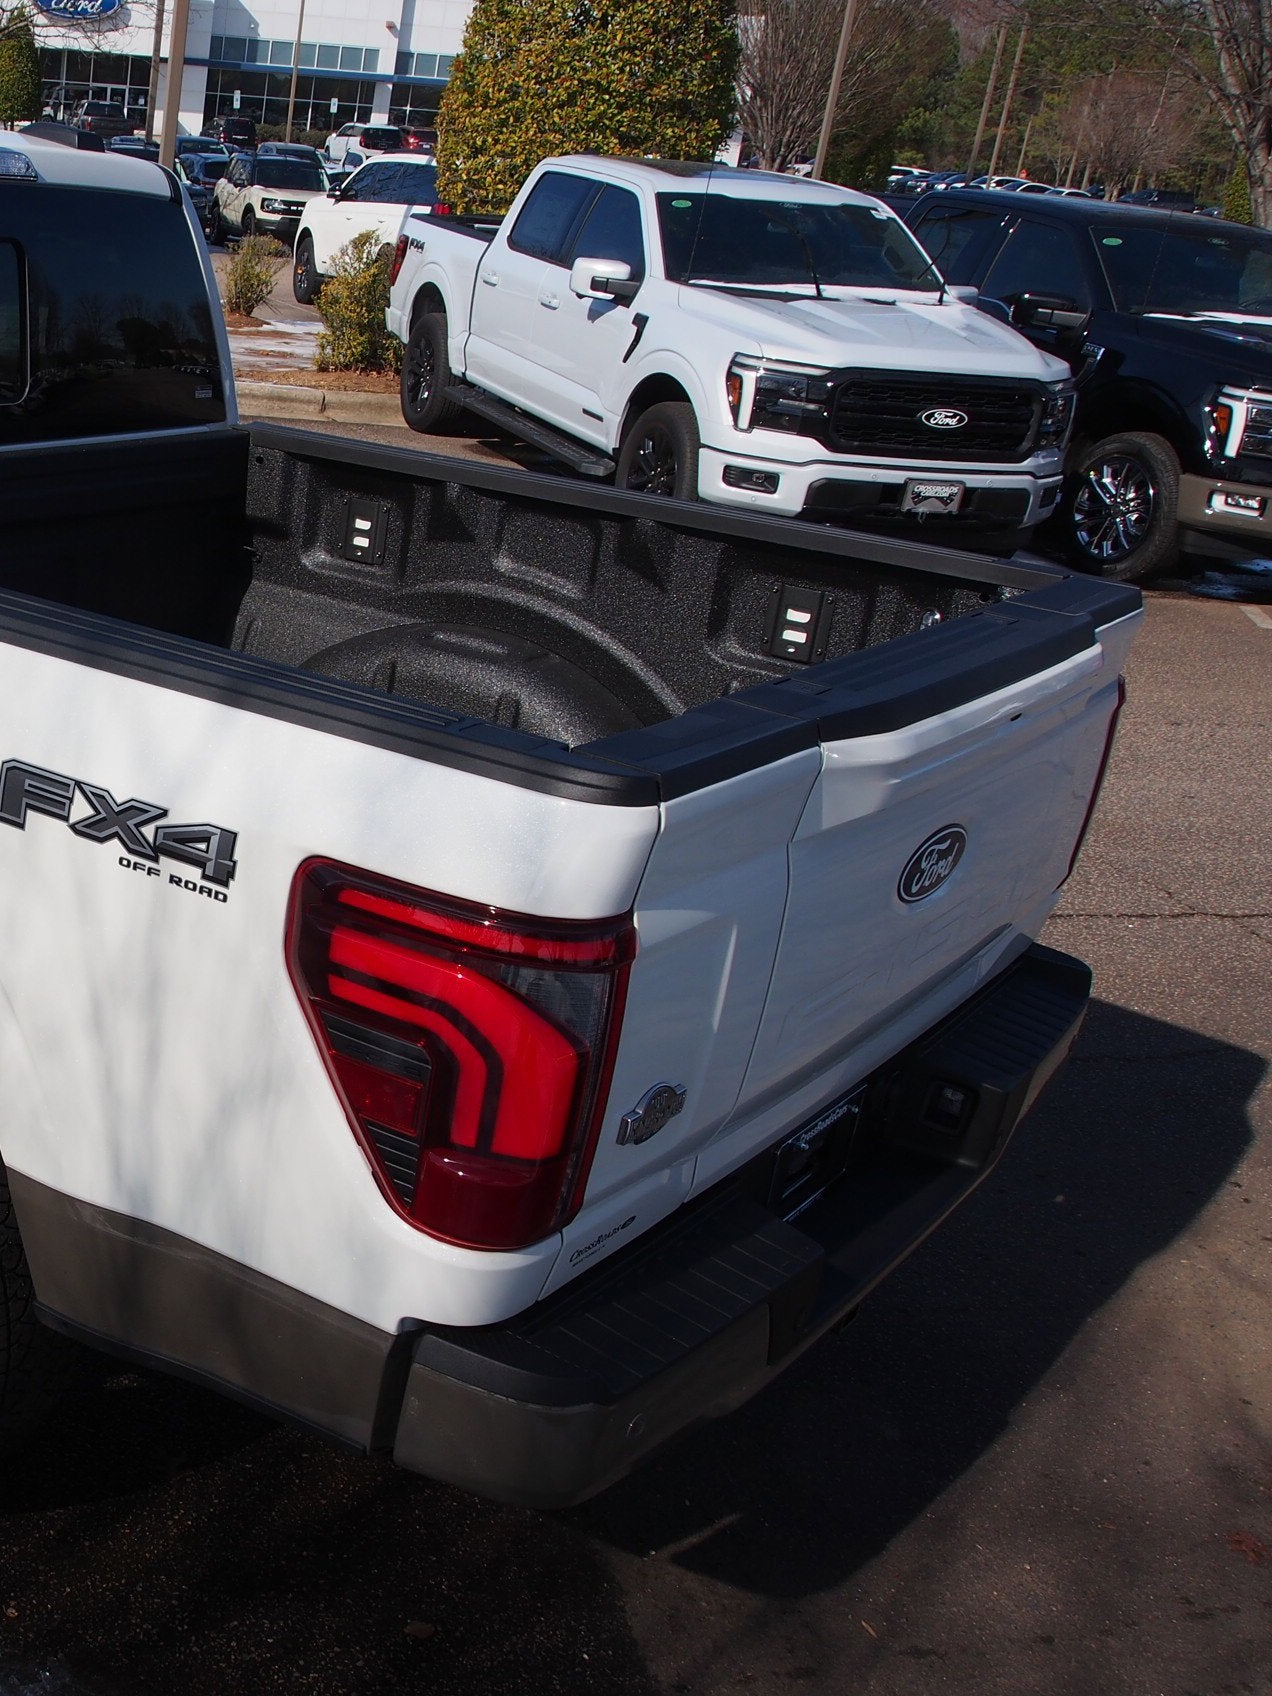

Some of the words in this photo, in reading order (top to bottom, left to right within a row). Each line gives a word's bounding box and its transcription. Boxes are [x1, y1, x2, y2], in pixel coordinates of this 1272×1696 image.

[930, 411, 960, 425] Ford
[914, 485, 960, 493] CROSSROADS
[118, 856, 161, 877] OFF
[168, 873, 228, 903] ROAD
[911, 838, 959, 893] Ford
